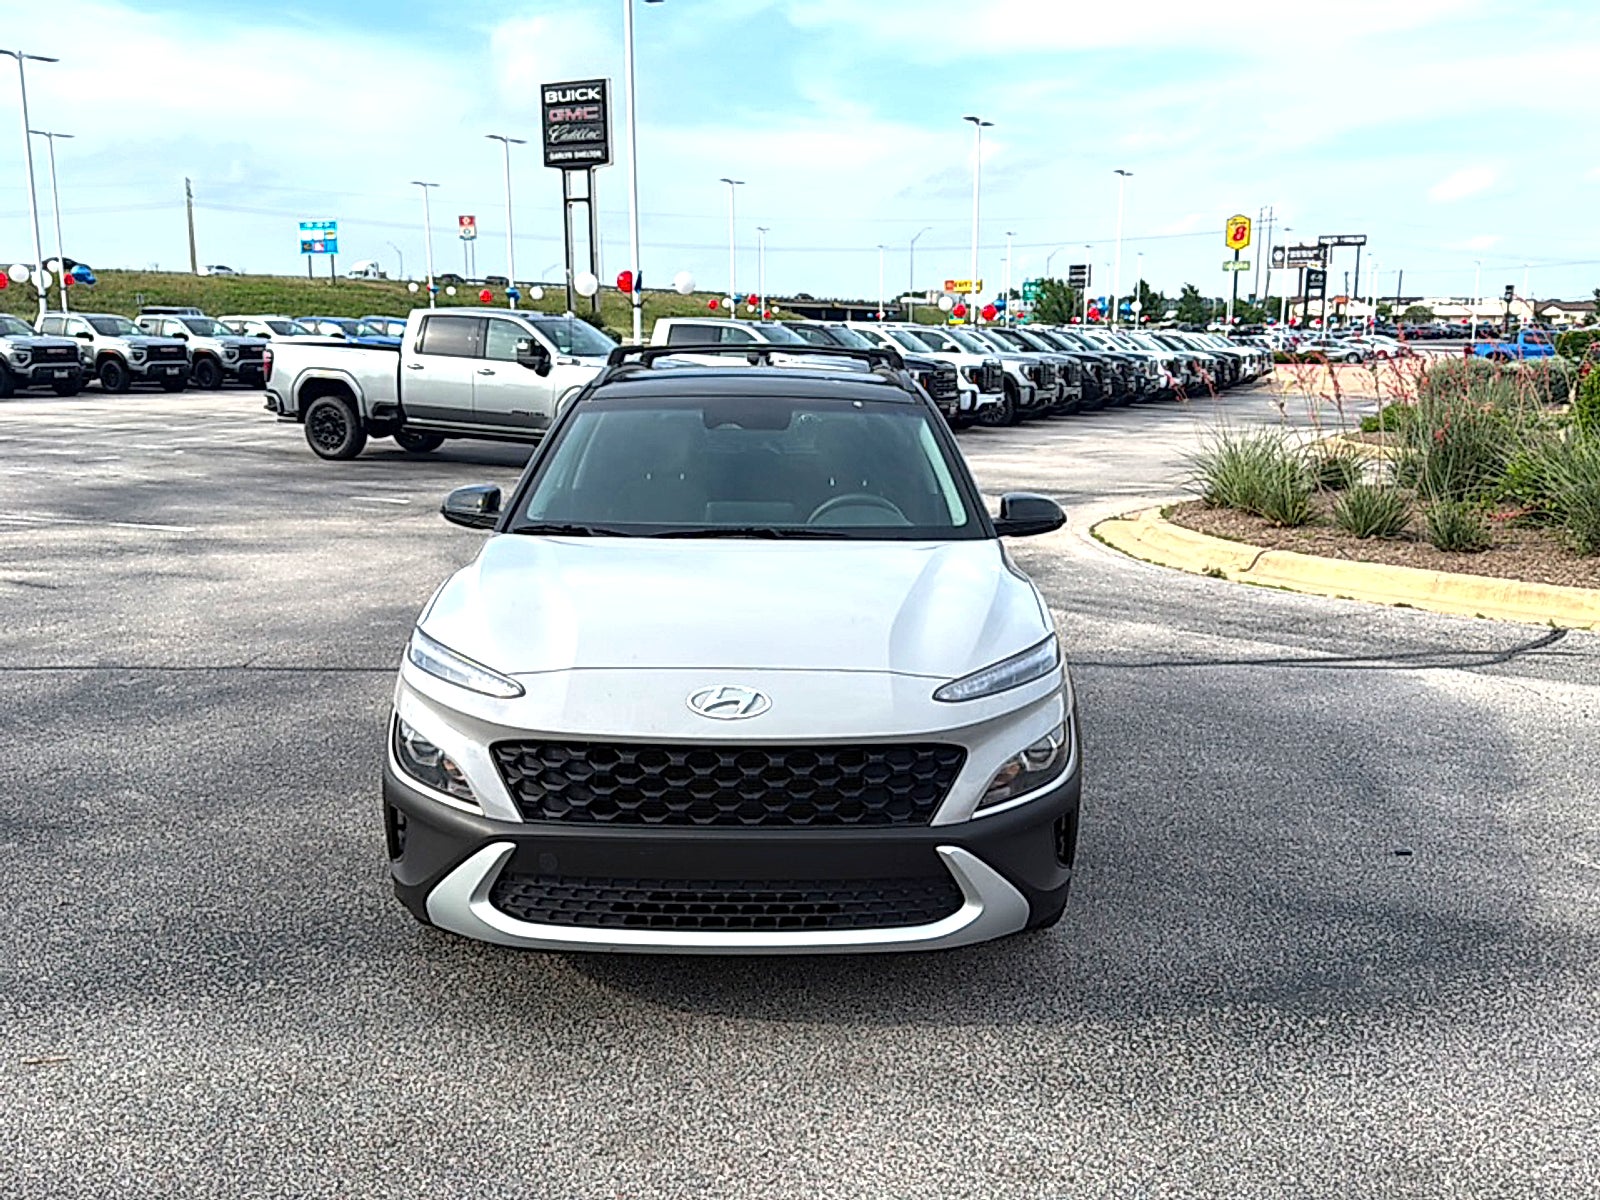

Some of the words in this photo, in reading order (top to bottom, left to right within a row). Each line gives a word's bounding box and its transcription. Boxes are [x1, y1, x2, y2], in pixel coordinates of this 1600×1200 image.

[545, 87, 601, 104] BUICK
[549, 106, 599, 122] GMC
[1233, 225, 1247, 242] 8
